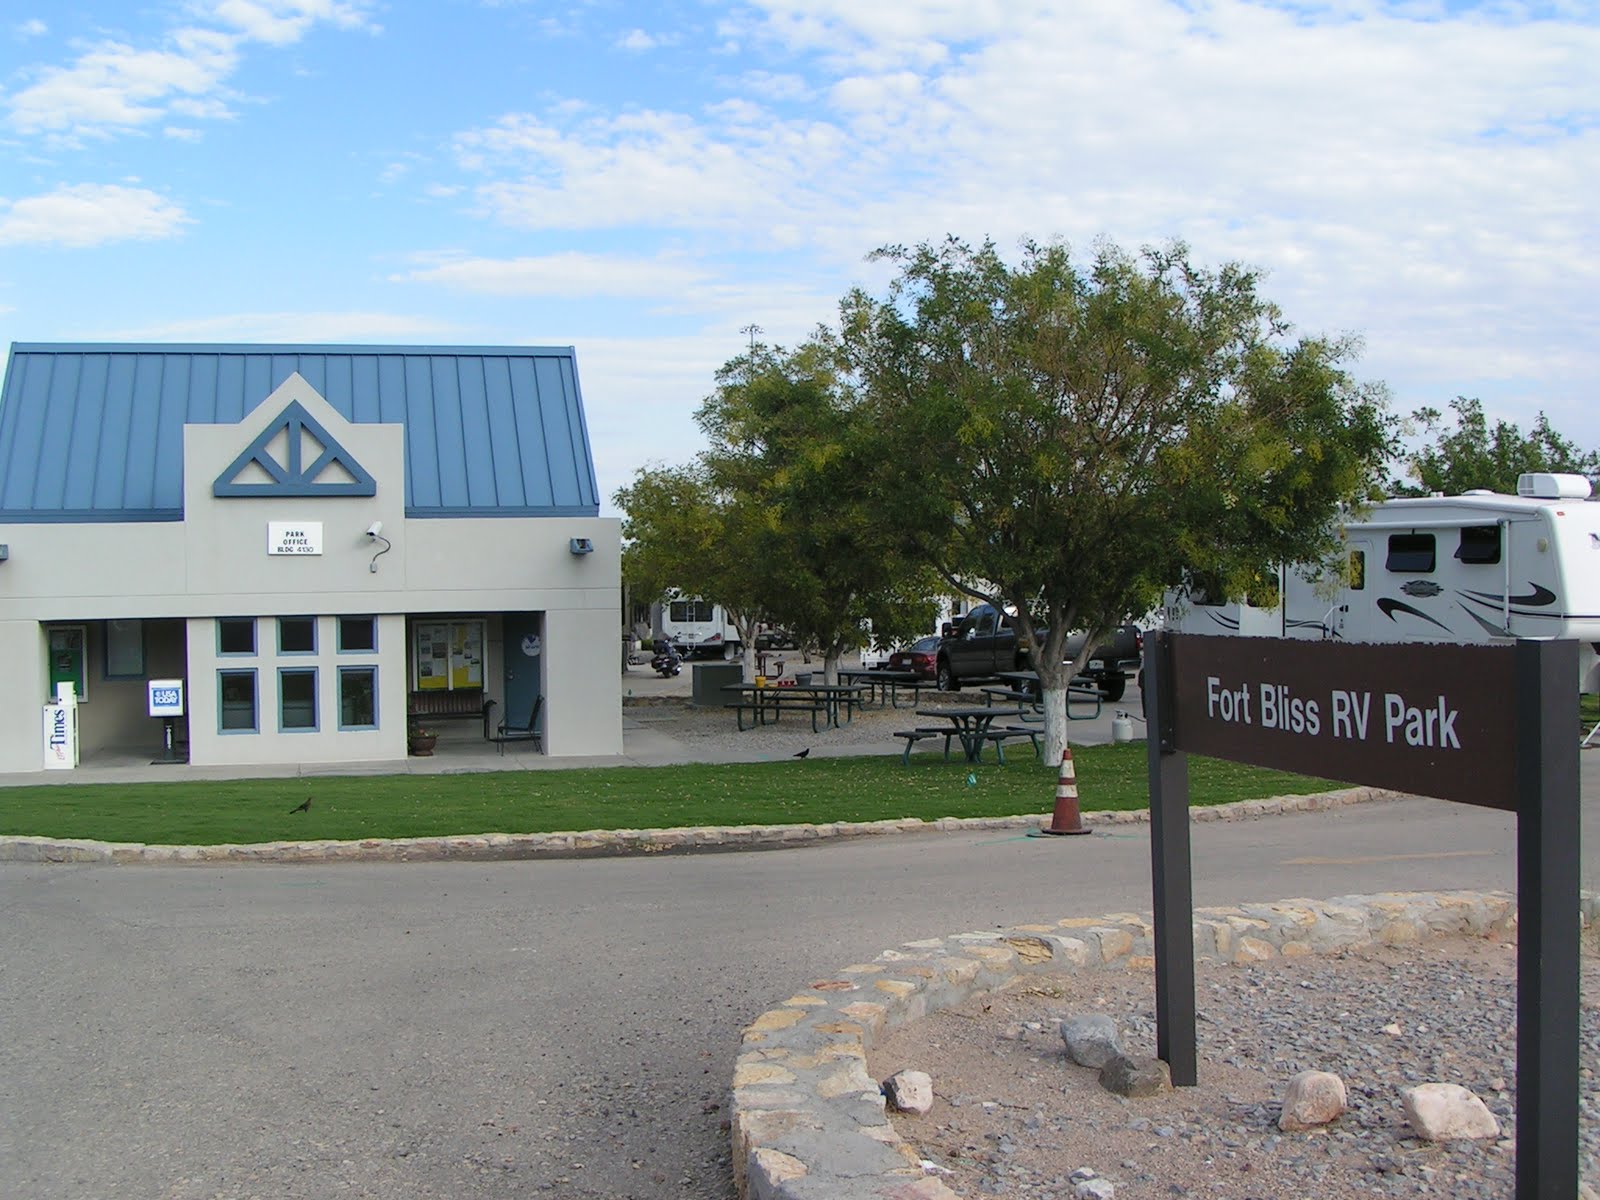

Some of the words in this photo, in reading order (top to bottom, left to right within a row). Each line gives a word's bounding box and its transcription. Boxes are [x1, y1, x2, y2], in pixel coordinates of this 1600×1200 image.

[155, 696, 178, 704] TODAY
[1207, 676, 1251, 724] Fort
[1260, 683, 1321, 736] Bliss
[1332, 690, 1371, 740] RV
[1384, 693, 1461, 749] Park
[50, 709, 65, 750] Times
